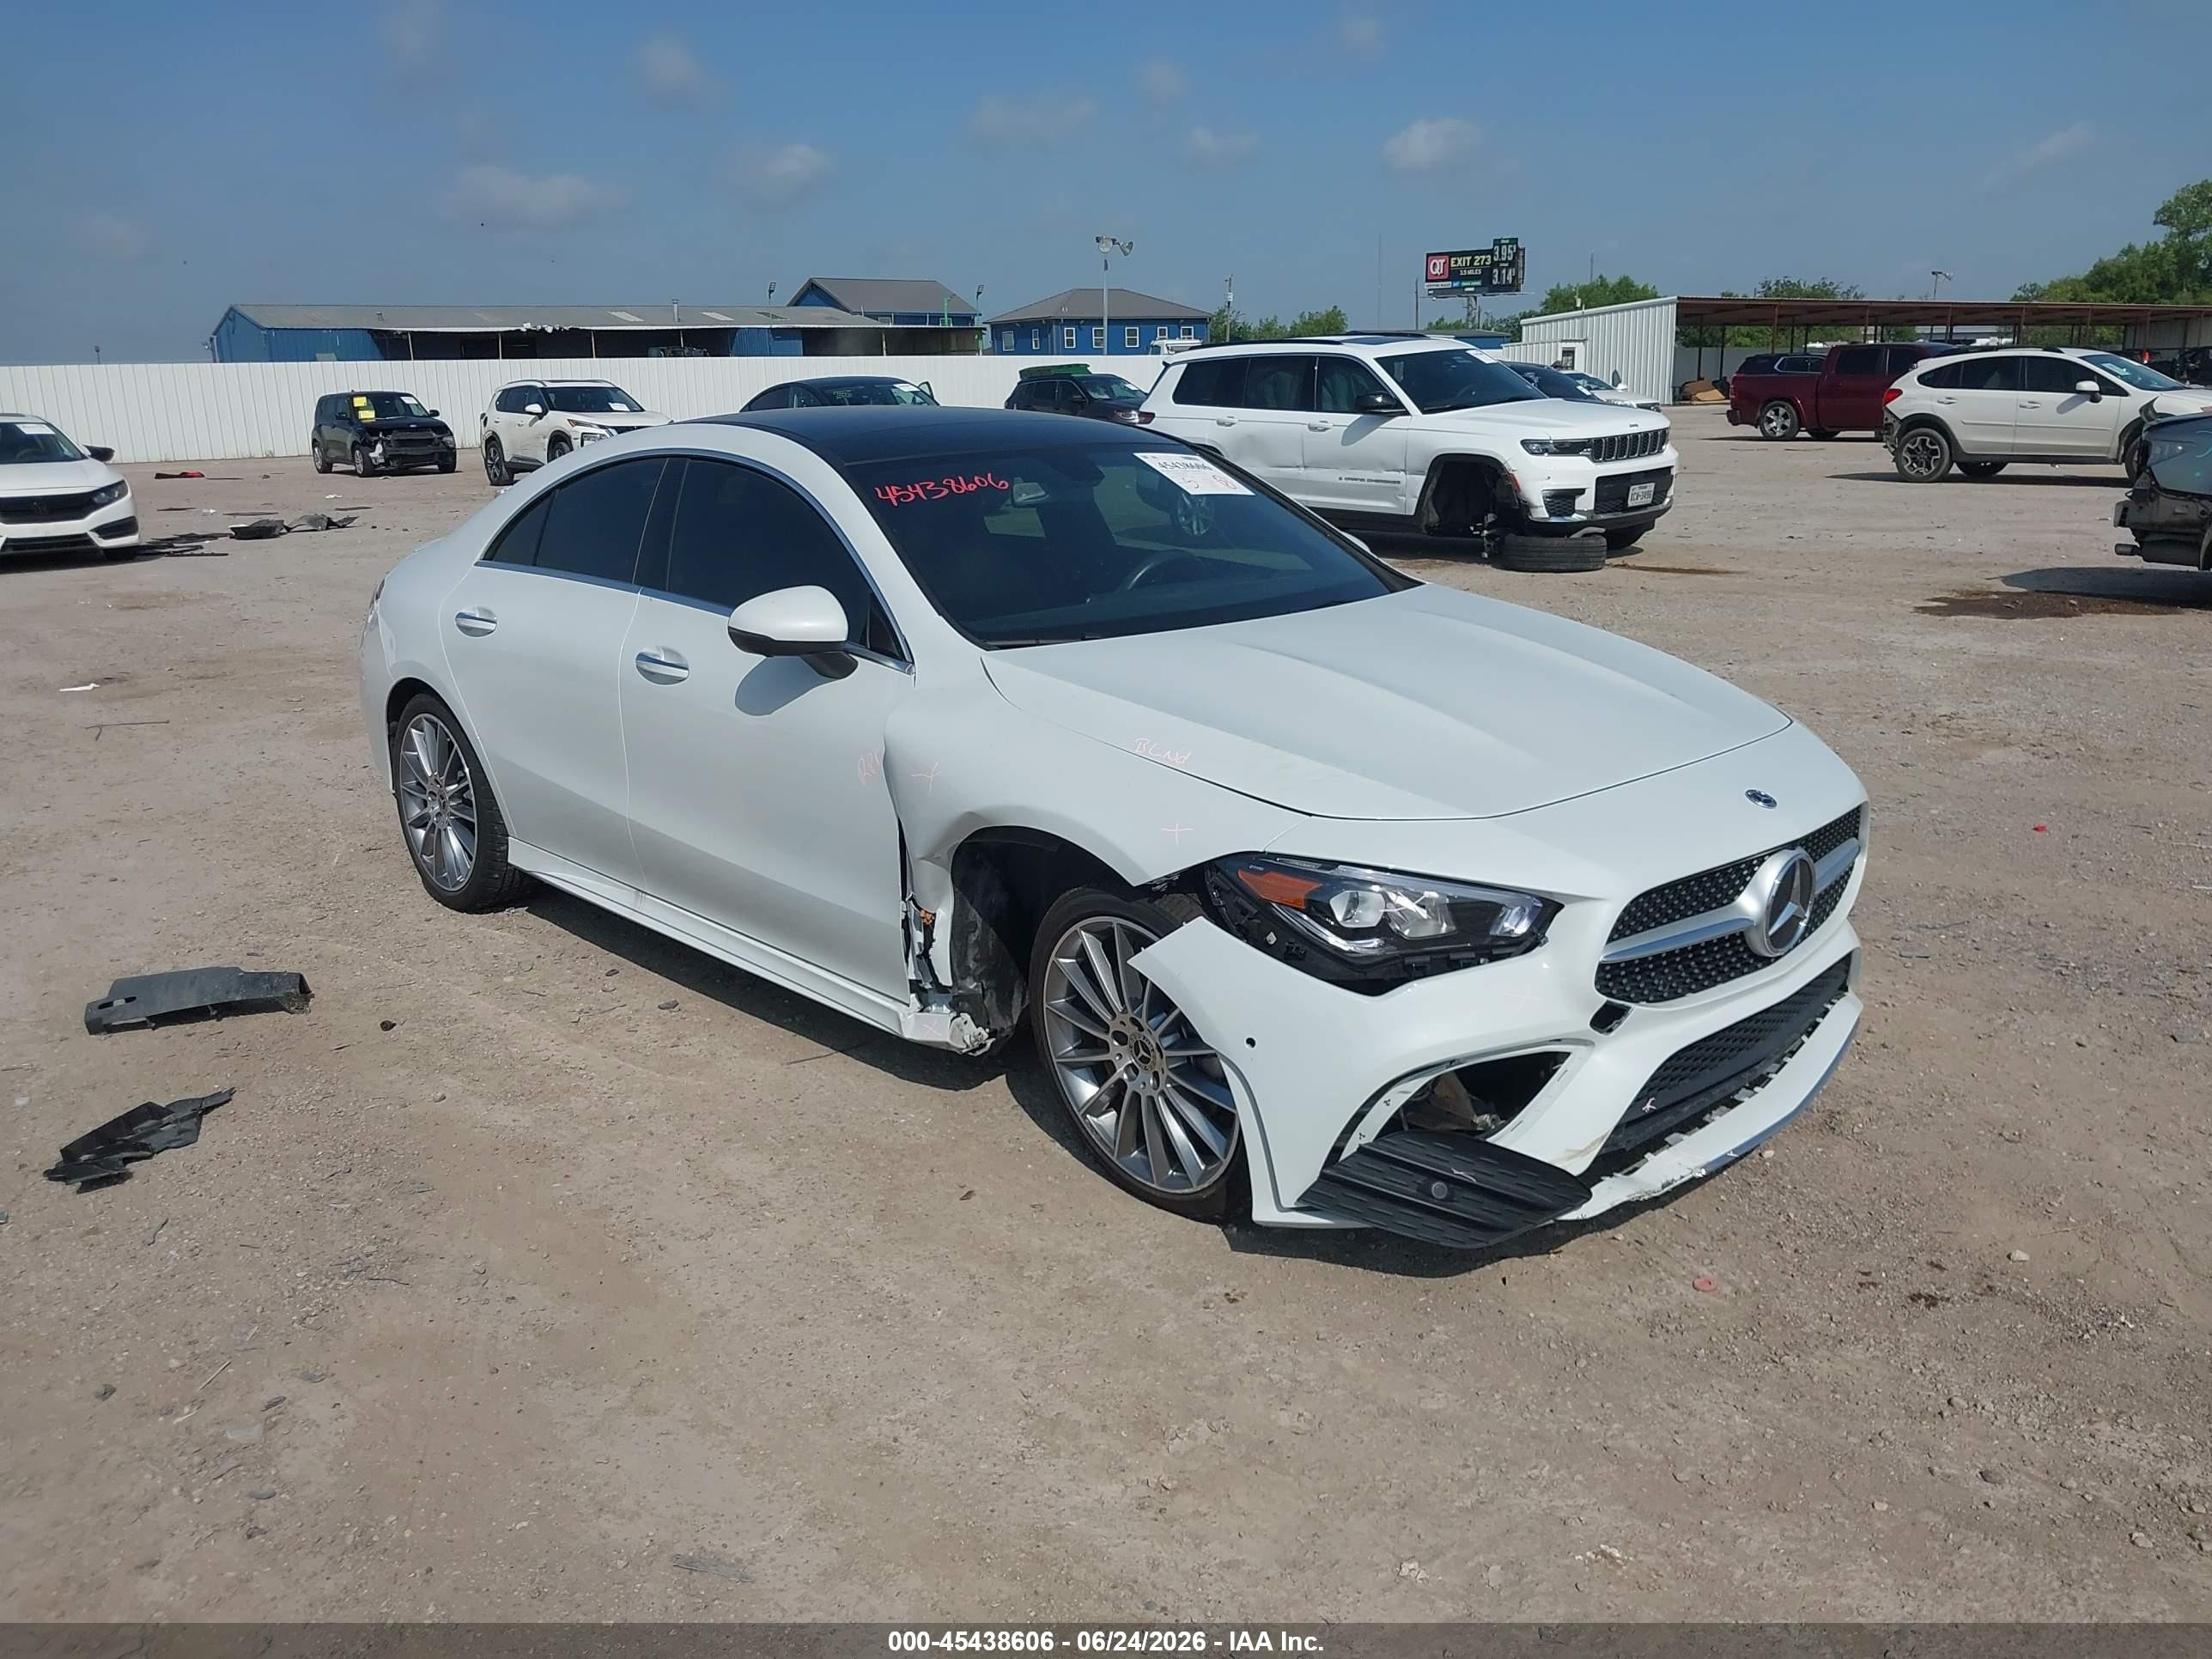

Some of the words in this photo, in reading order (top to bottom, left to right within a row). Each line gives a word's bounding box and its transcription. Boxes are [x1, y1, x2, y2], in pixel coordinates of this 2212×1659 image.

[1430, 258, 1445, 275] QT
[1450, 256, 1472, 267] EXIT
[1474, 255, 1492, 266] 273
[874, 472, 1009, 507] 45438606
